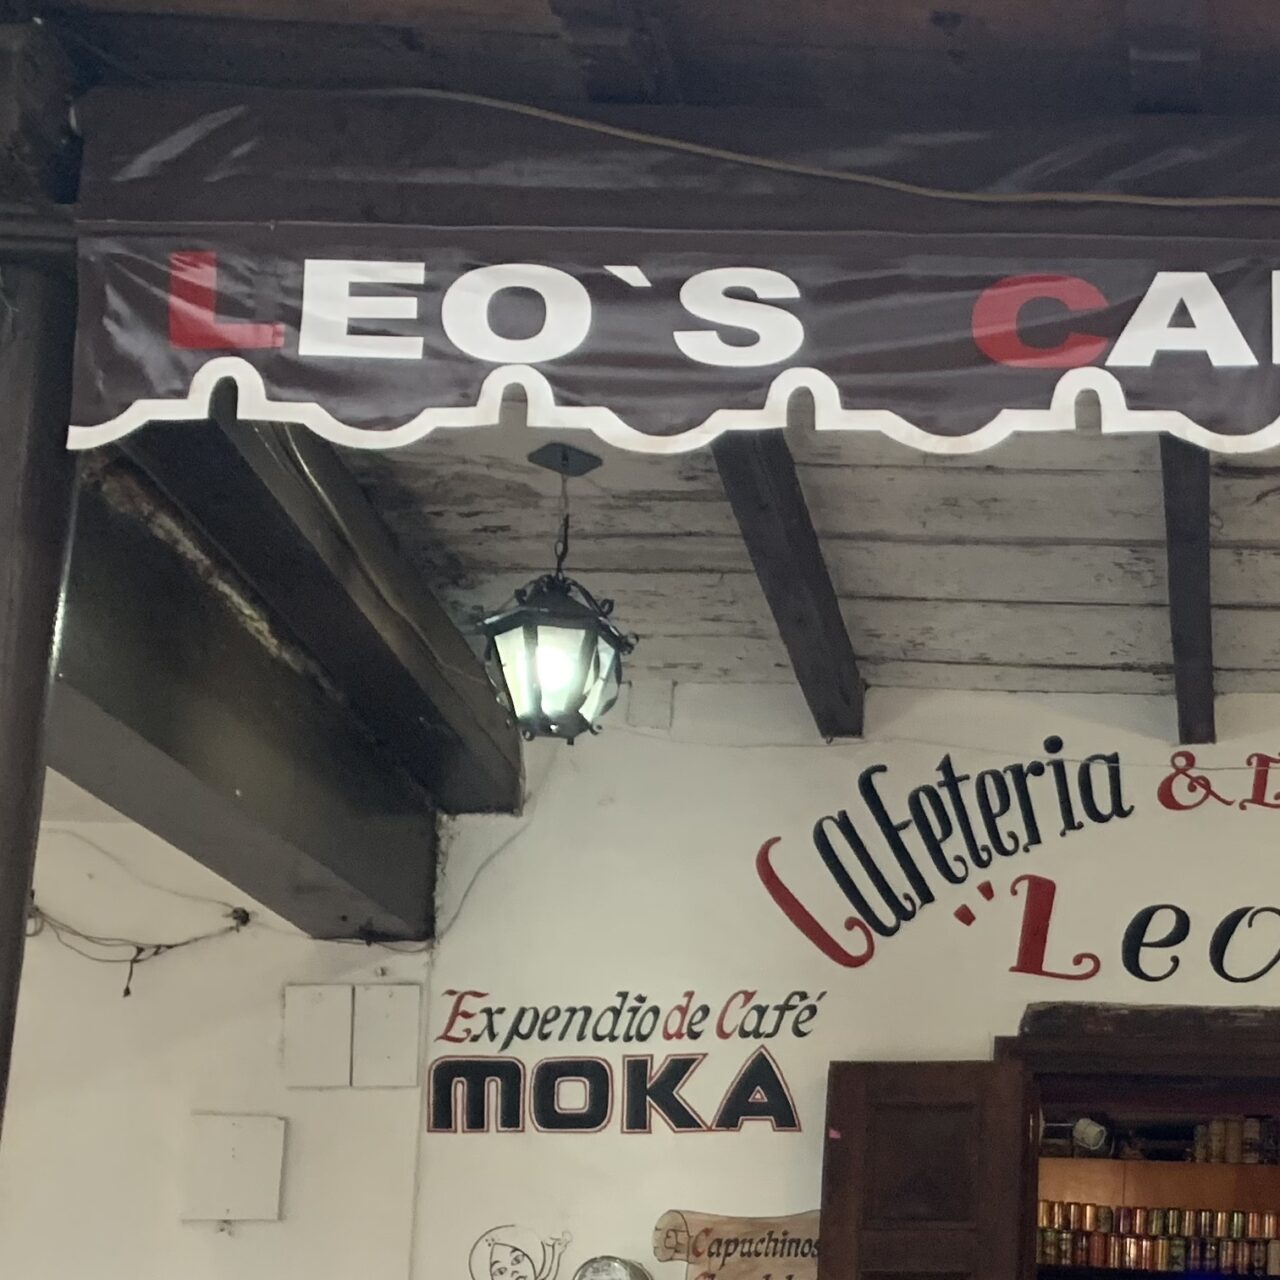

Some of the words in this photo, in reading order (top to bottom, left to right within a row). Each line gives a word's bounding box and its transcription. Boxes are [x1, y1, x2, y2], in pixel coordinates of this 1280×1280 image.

[755, 735, 1135, 969] Cafeteria
[1156, 748, 1235, 811] &
[434, 988, 661, 1052] Expendio
[662, 990, 711, 1041] de
[715, 989, 828, 1041] Café
[426, 1043, 803, 1135] MOKA
